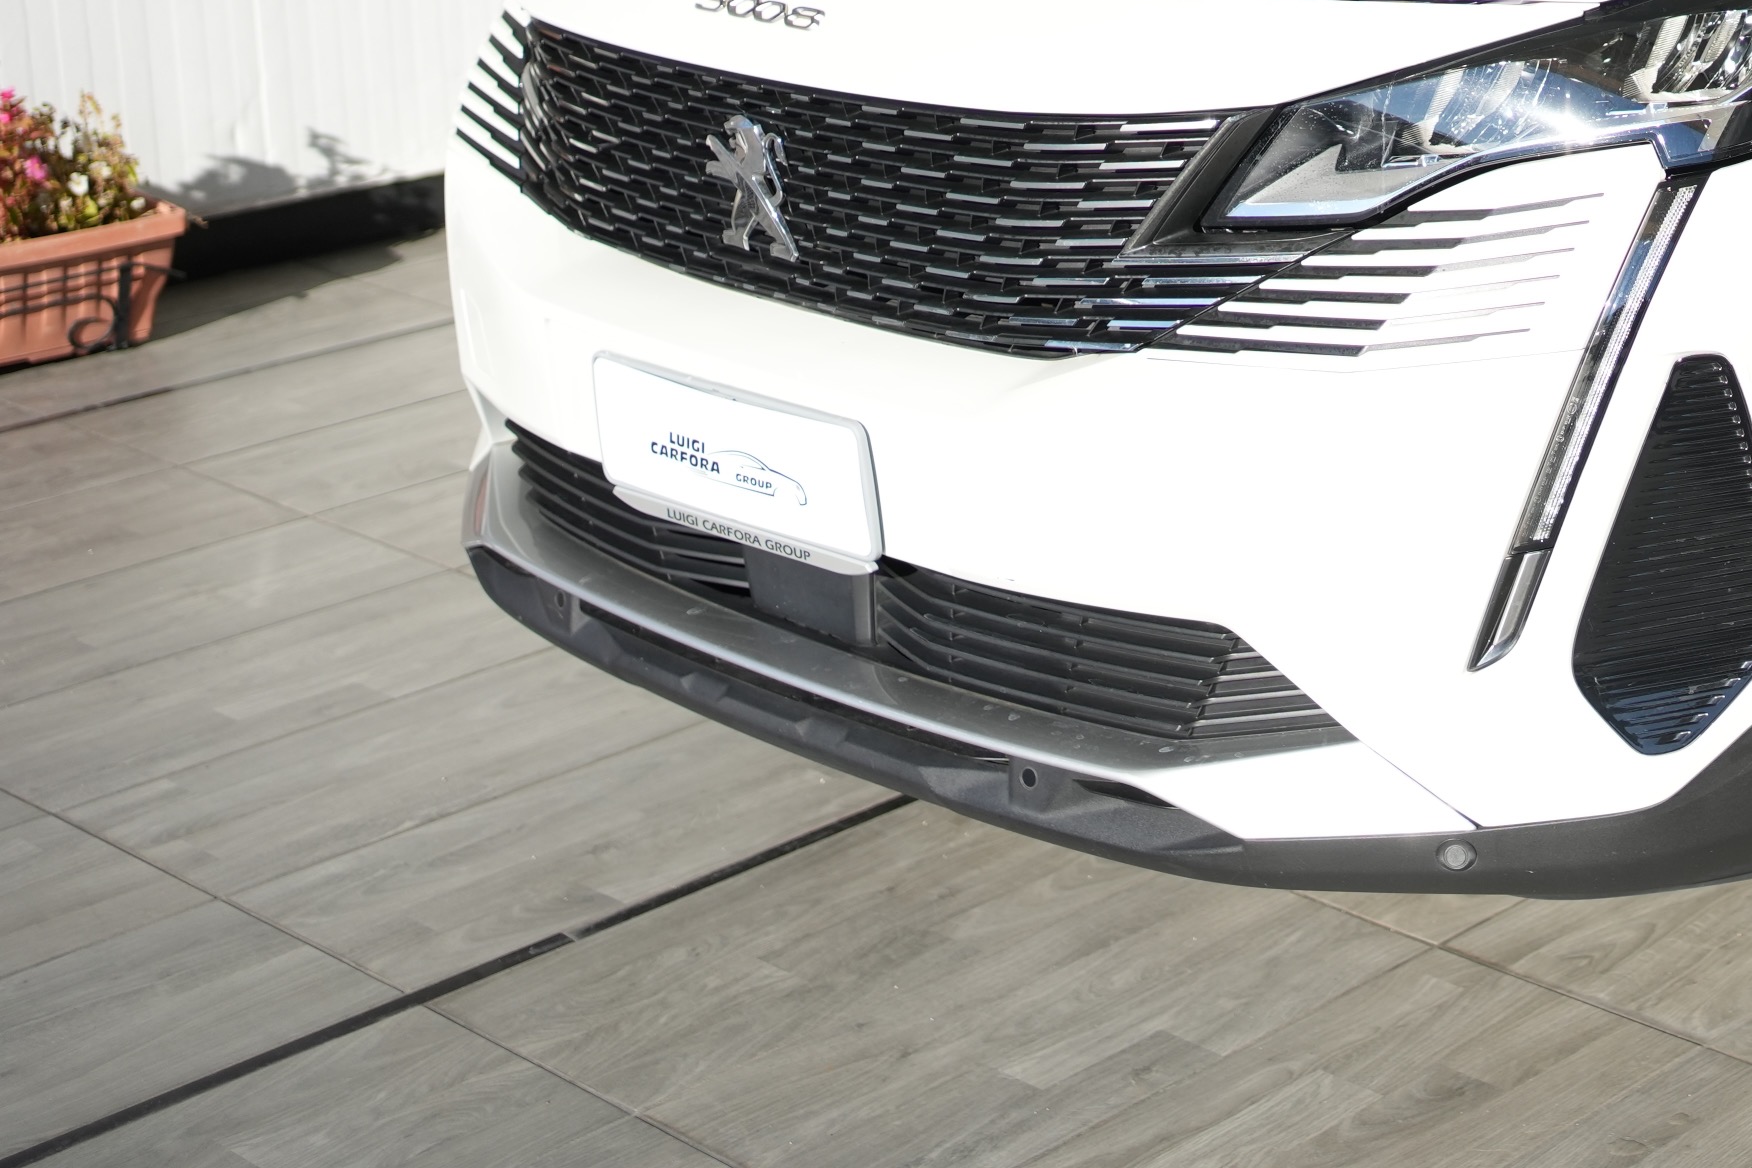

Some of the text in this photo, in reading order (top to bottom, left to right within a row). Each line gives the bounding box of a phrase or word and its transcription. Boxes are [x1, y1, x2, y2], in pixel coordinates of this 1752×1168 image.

[669, 431, 705, 454] LUIGI
[651, 441, 720, 474] CARFORA
[735, 473, 772, 489] GROUP
[667, 508, 810, 560] LUIGI CARFORA GROUP
